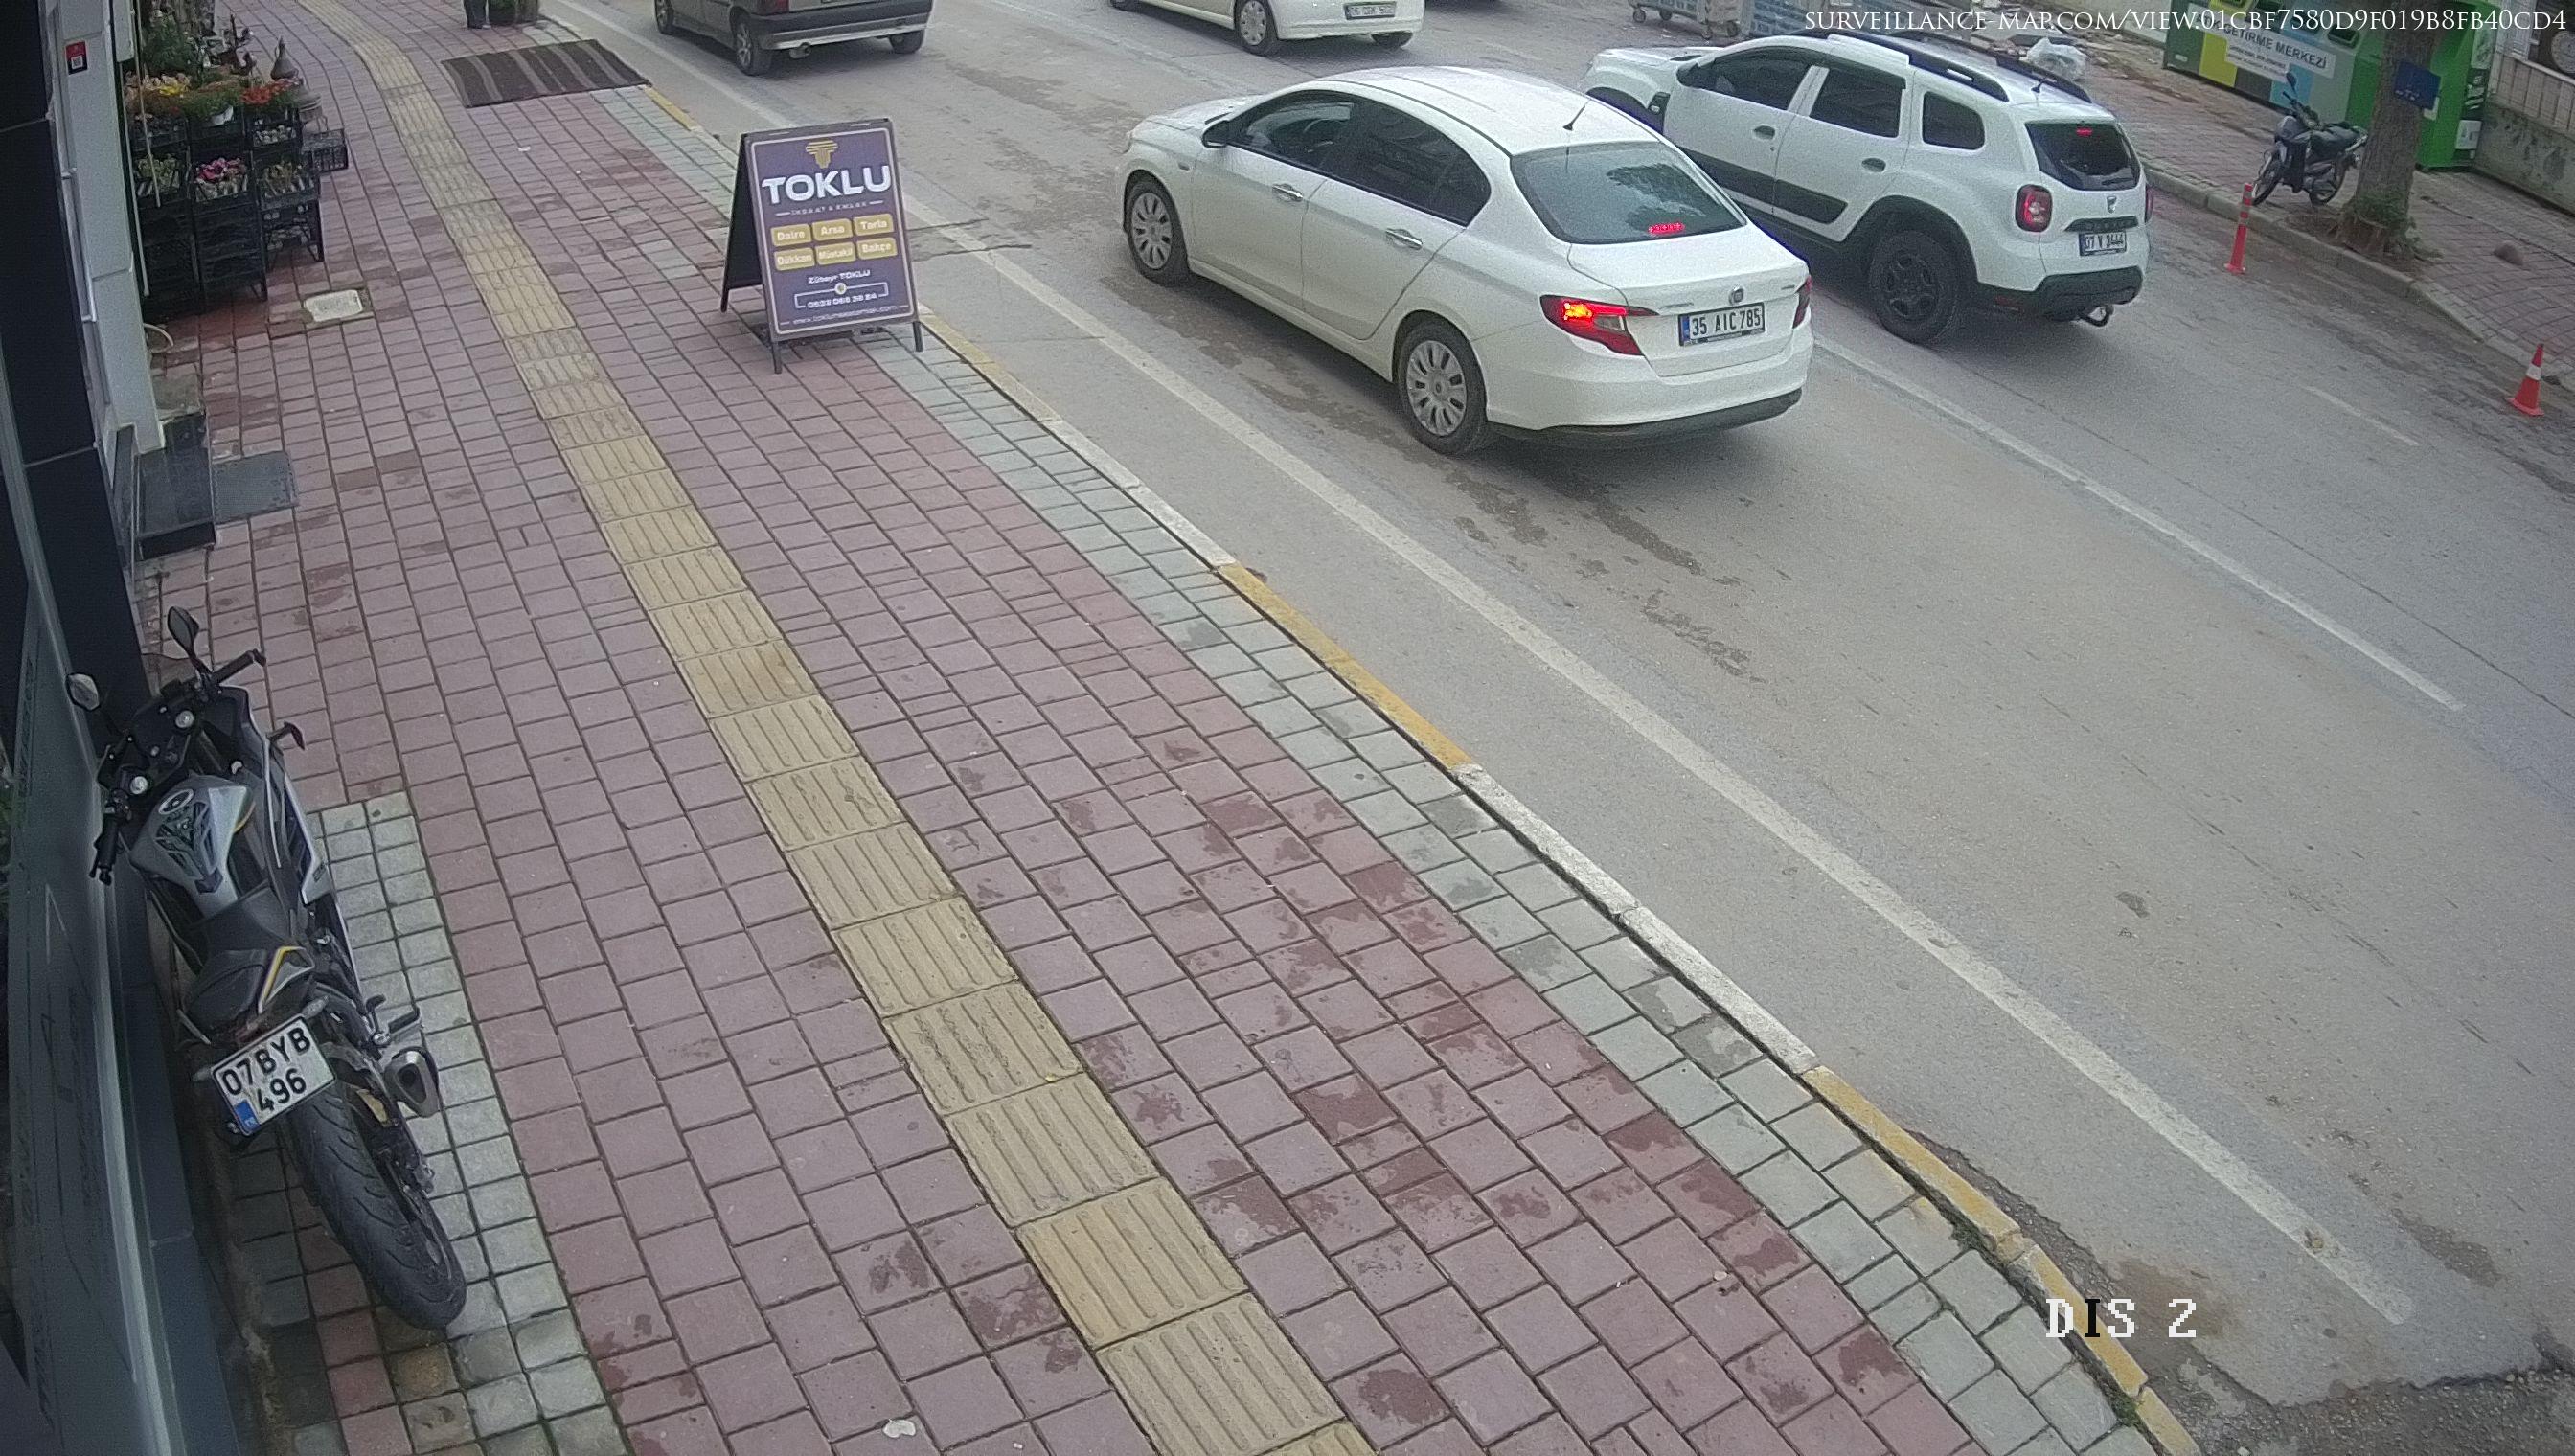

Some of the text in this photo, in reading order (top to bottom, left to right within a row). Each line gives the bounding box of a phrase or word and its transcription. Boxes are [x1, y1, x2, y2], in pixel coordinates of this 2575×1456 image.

[762, 165, 892, 204] TOKLU
[860, 219, 888, 230] Tarla
[777, 230, 805, 241] Daire
[821, 225, 845, 236] Arsa
[839, 269, 871, 280] TOKLU
[1692, 308, 1761, 336] 35 AIC 785
[257, 1068, 307, 1111] 496
